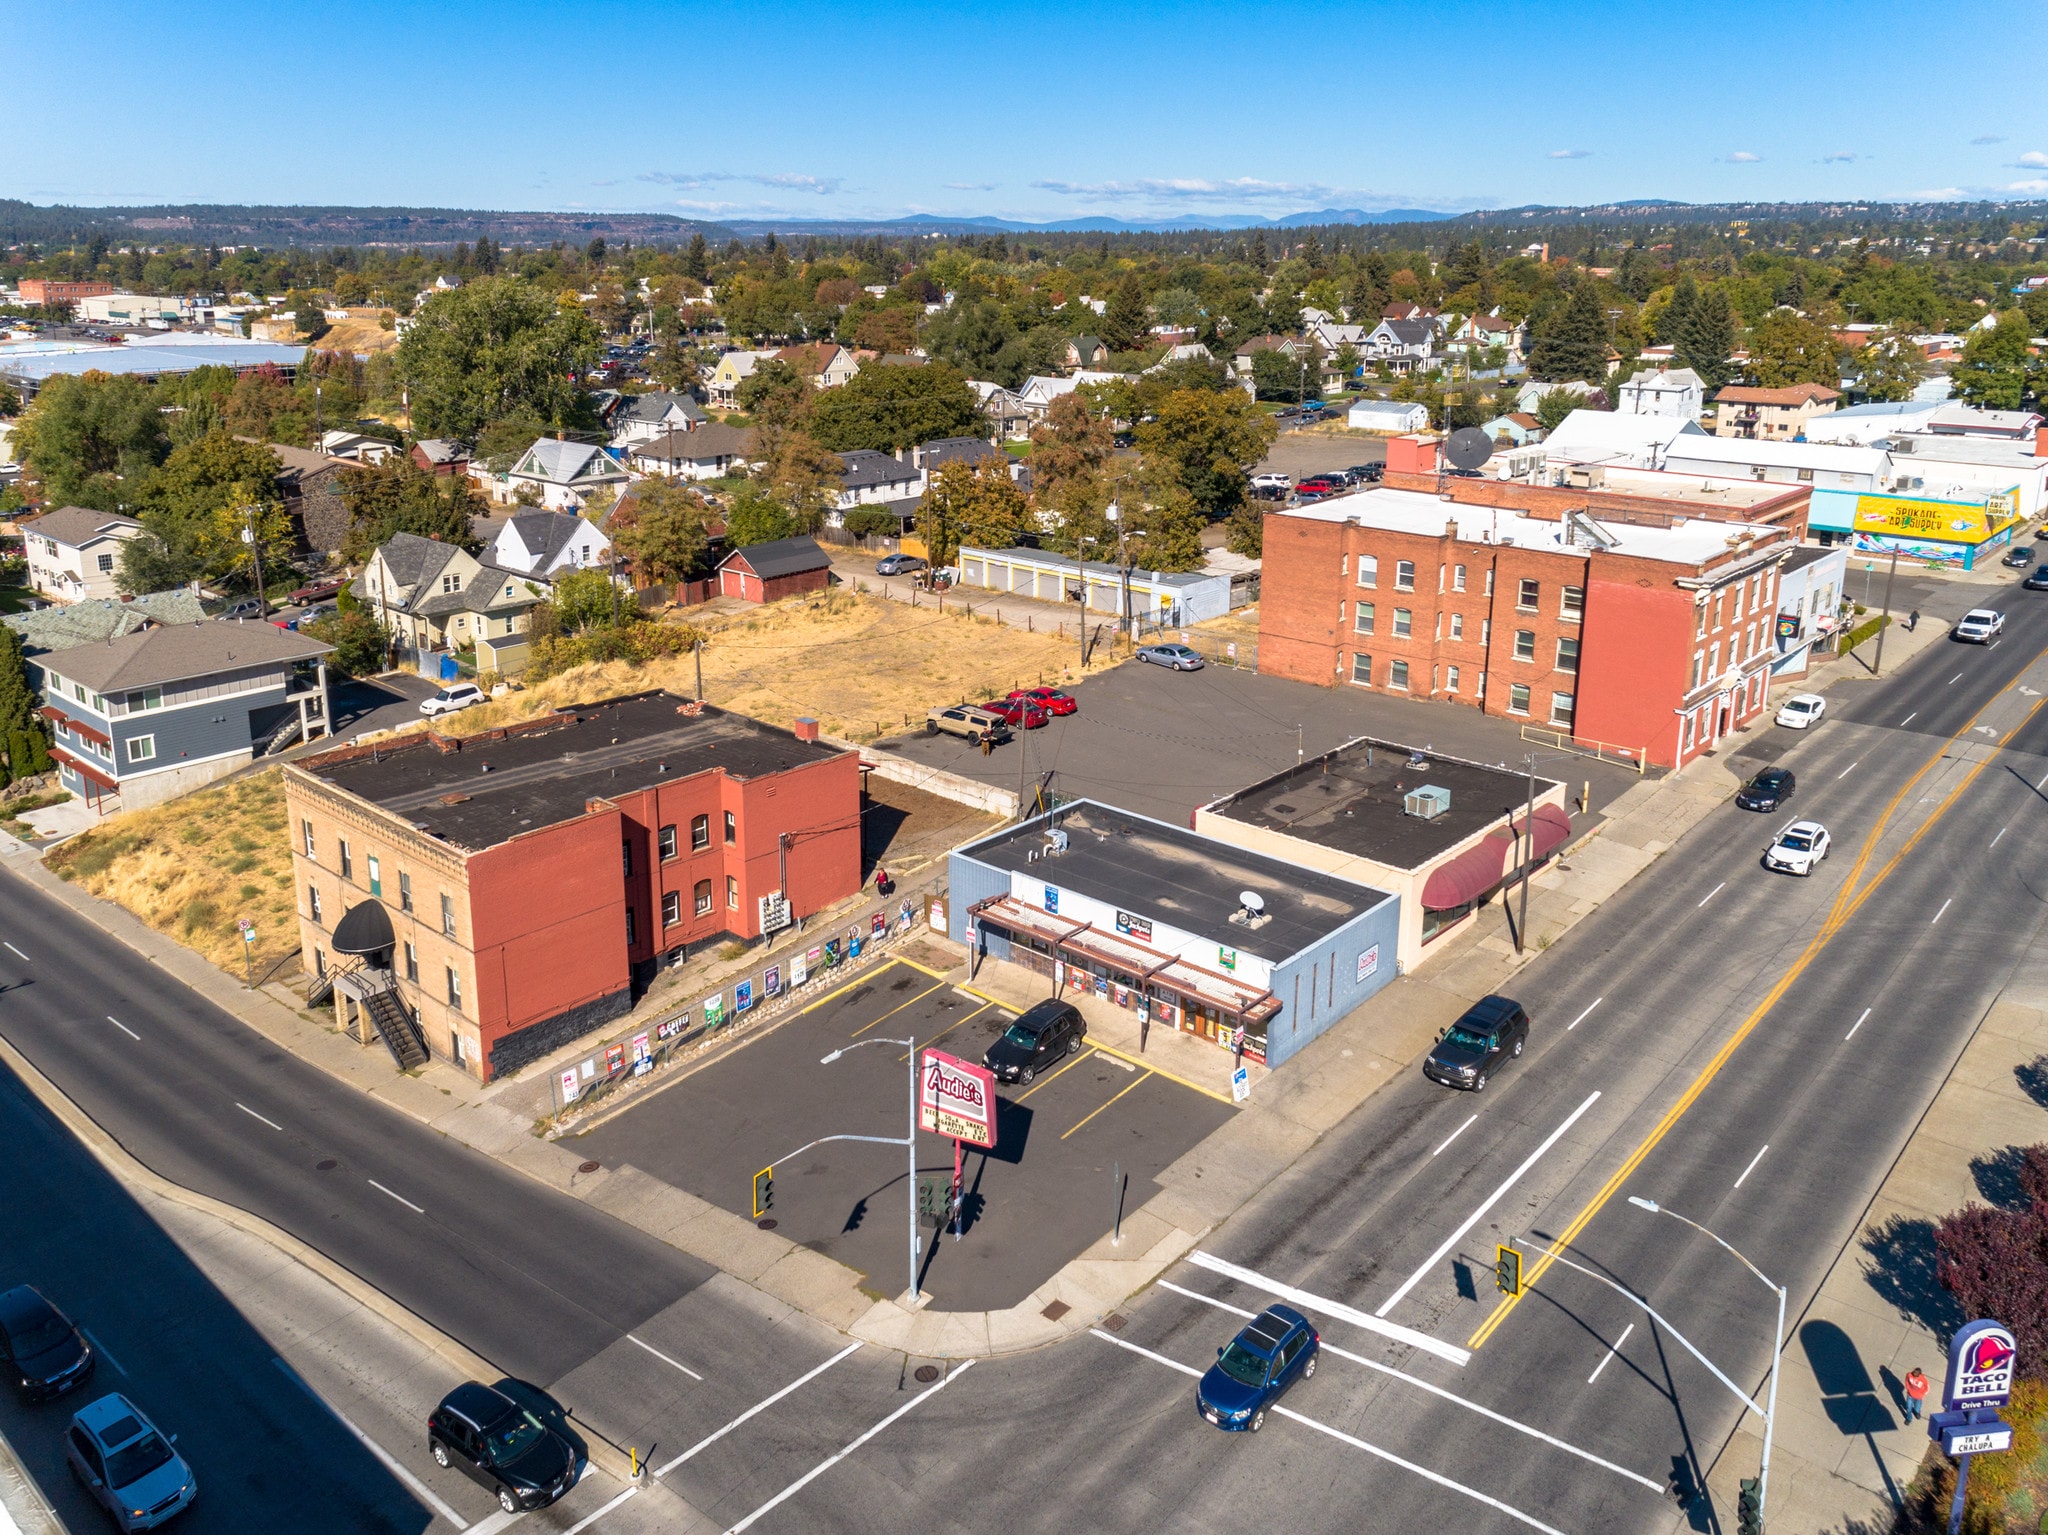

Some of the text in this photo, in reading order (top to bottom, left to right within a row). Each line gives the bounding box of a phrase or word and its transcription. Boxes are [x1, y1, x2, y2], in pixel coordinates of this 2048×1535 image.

[1895, 506, 1938, 519] SPOKANE
[1888, 516, 1943, 530] ART SUPPLY
[927, 1067, 983, 1107] Audie's
[1960, 1372, 2008, 1385] TACO
[1961, 1383, 2007, 1395] BELL
[1961, 1401, 1982, 1410] Drive
[1965, 1435, 1979, 1444] TRY
[1958, 1441, 1994, 1453] CHALUPA
